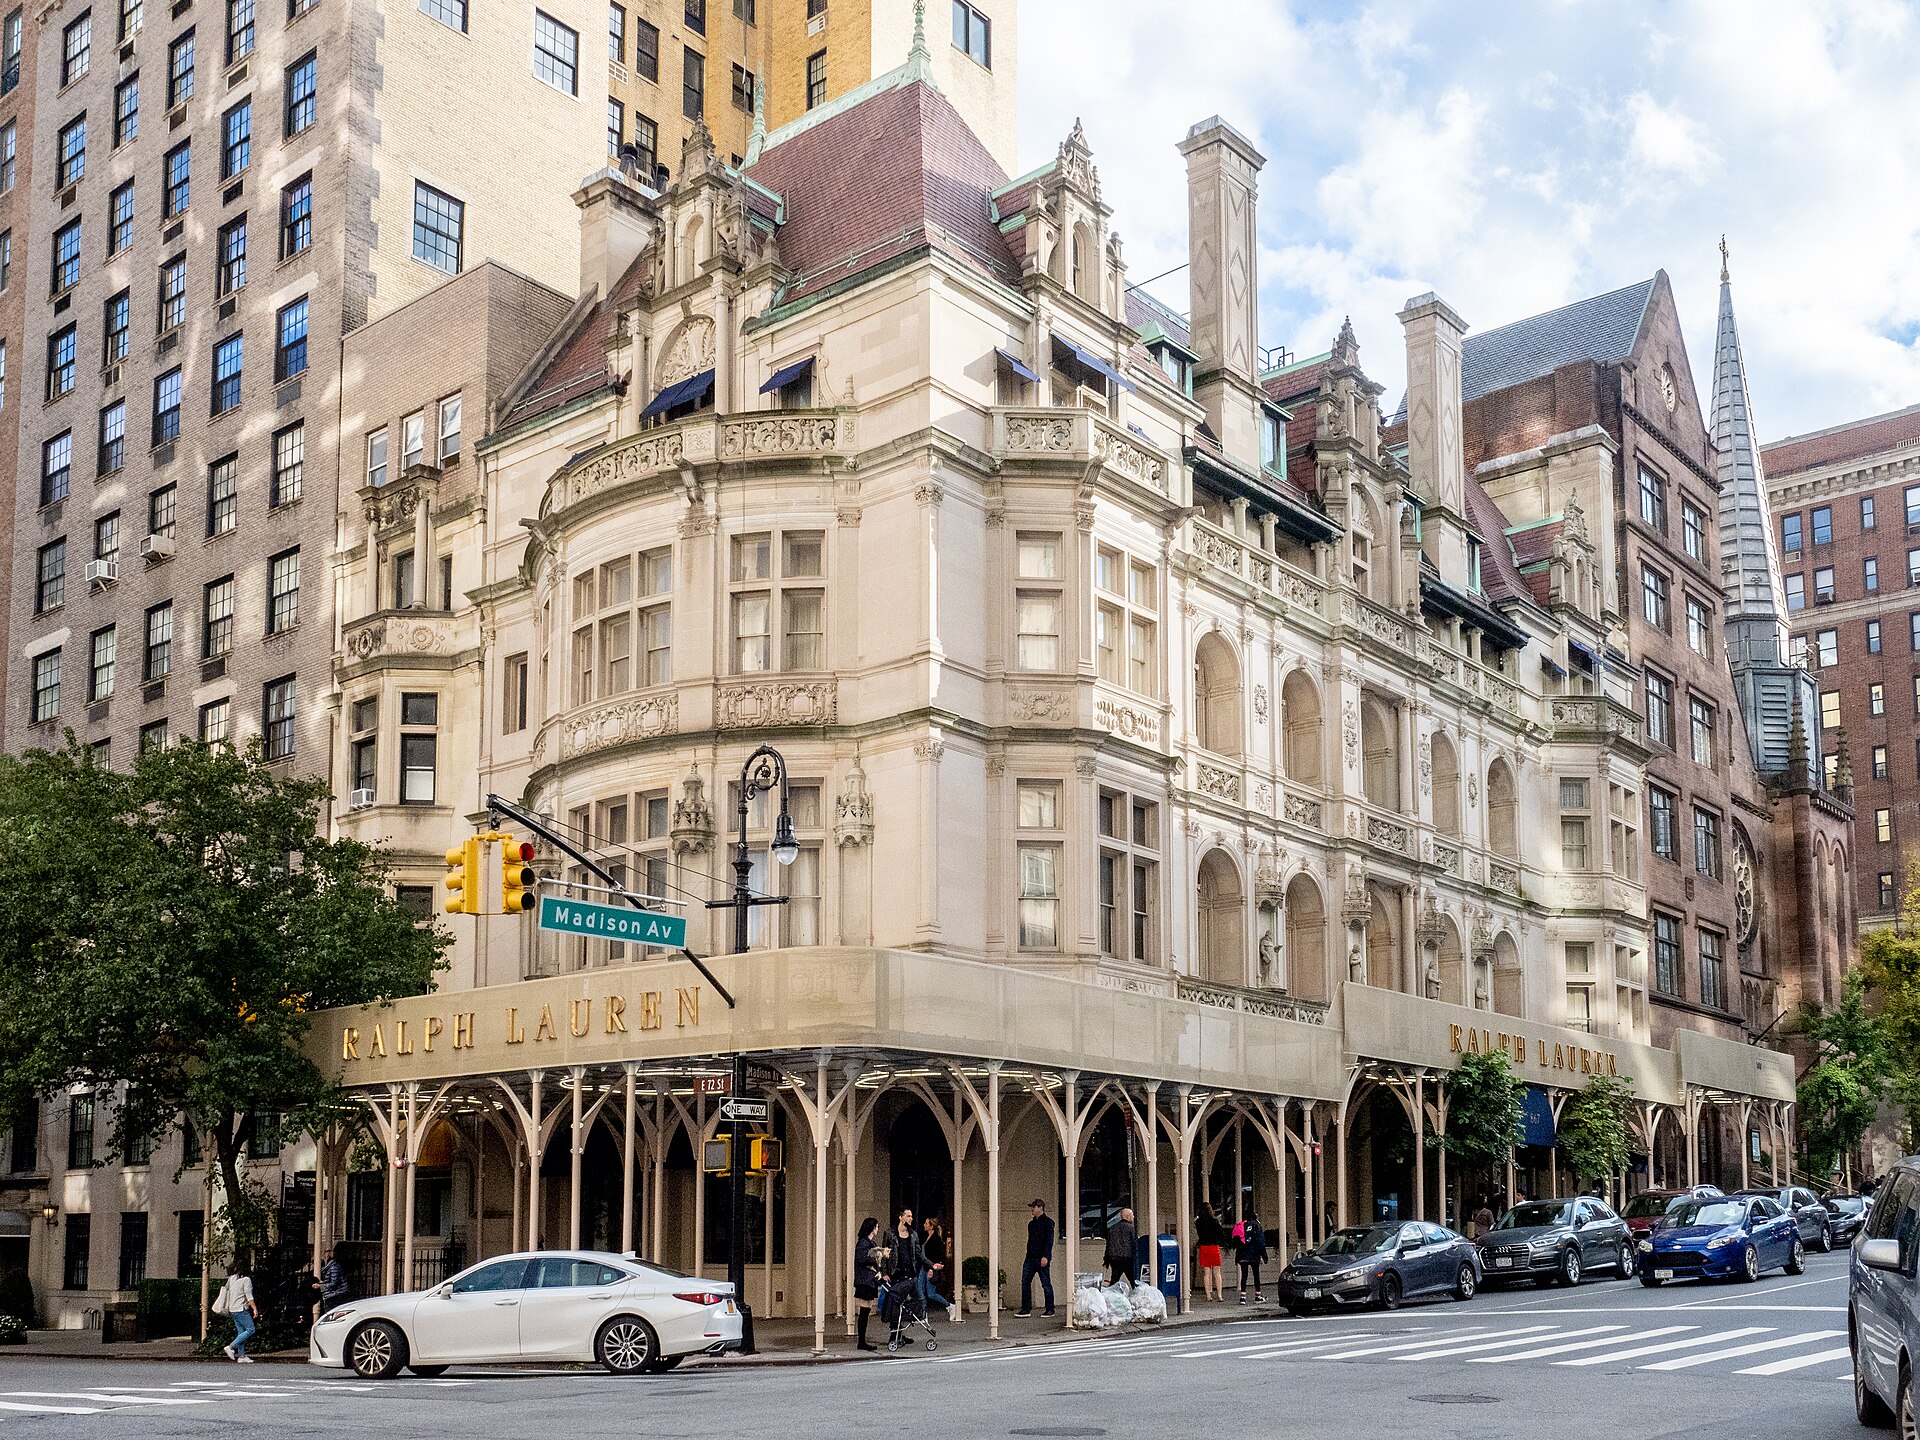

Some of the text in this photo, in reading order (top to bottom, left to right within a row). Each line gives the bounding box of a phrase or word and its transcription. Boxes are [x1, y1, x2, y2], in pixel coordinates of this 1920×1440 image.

[555, 906, 672, 939] Madison Av
[341, 985, 701, 1061] RALPH LAUREN
[1450, 1023, 1617, 1076] RALPH LAUREN
[748, 1066, 772, 1080] Madison
[701, 1078, 725, 1091] E 72 St
[725, 1104, 765, 1115] ONE WAY
[1382, 1206, 1389, 1215] P
